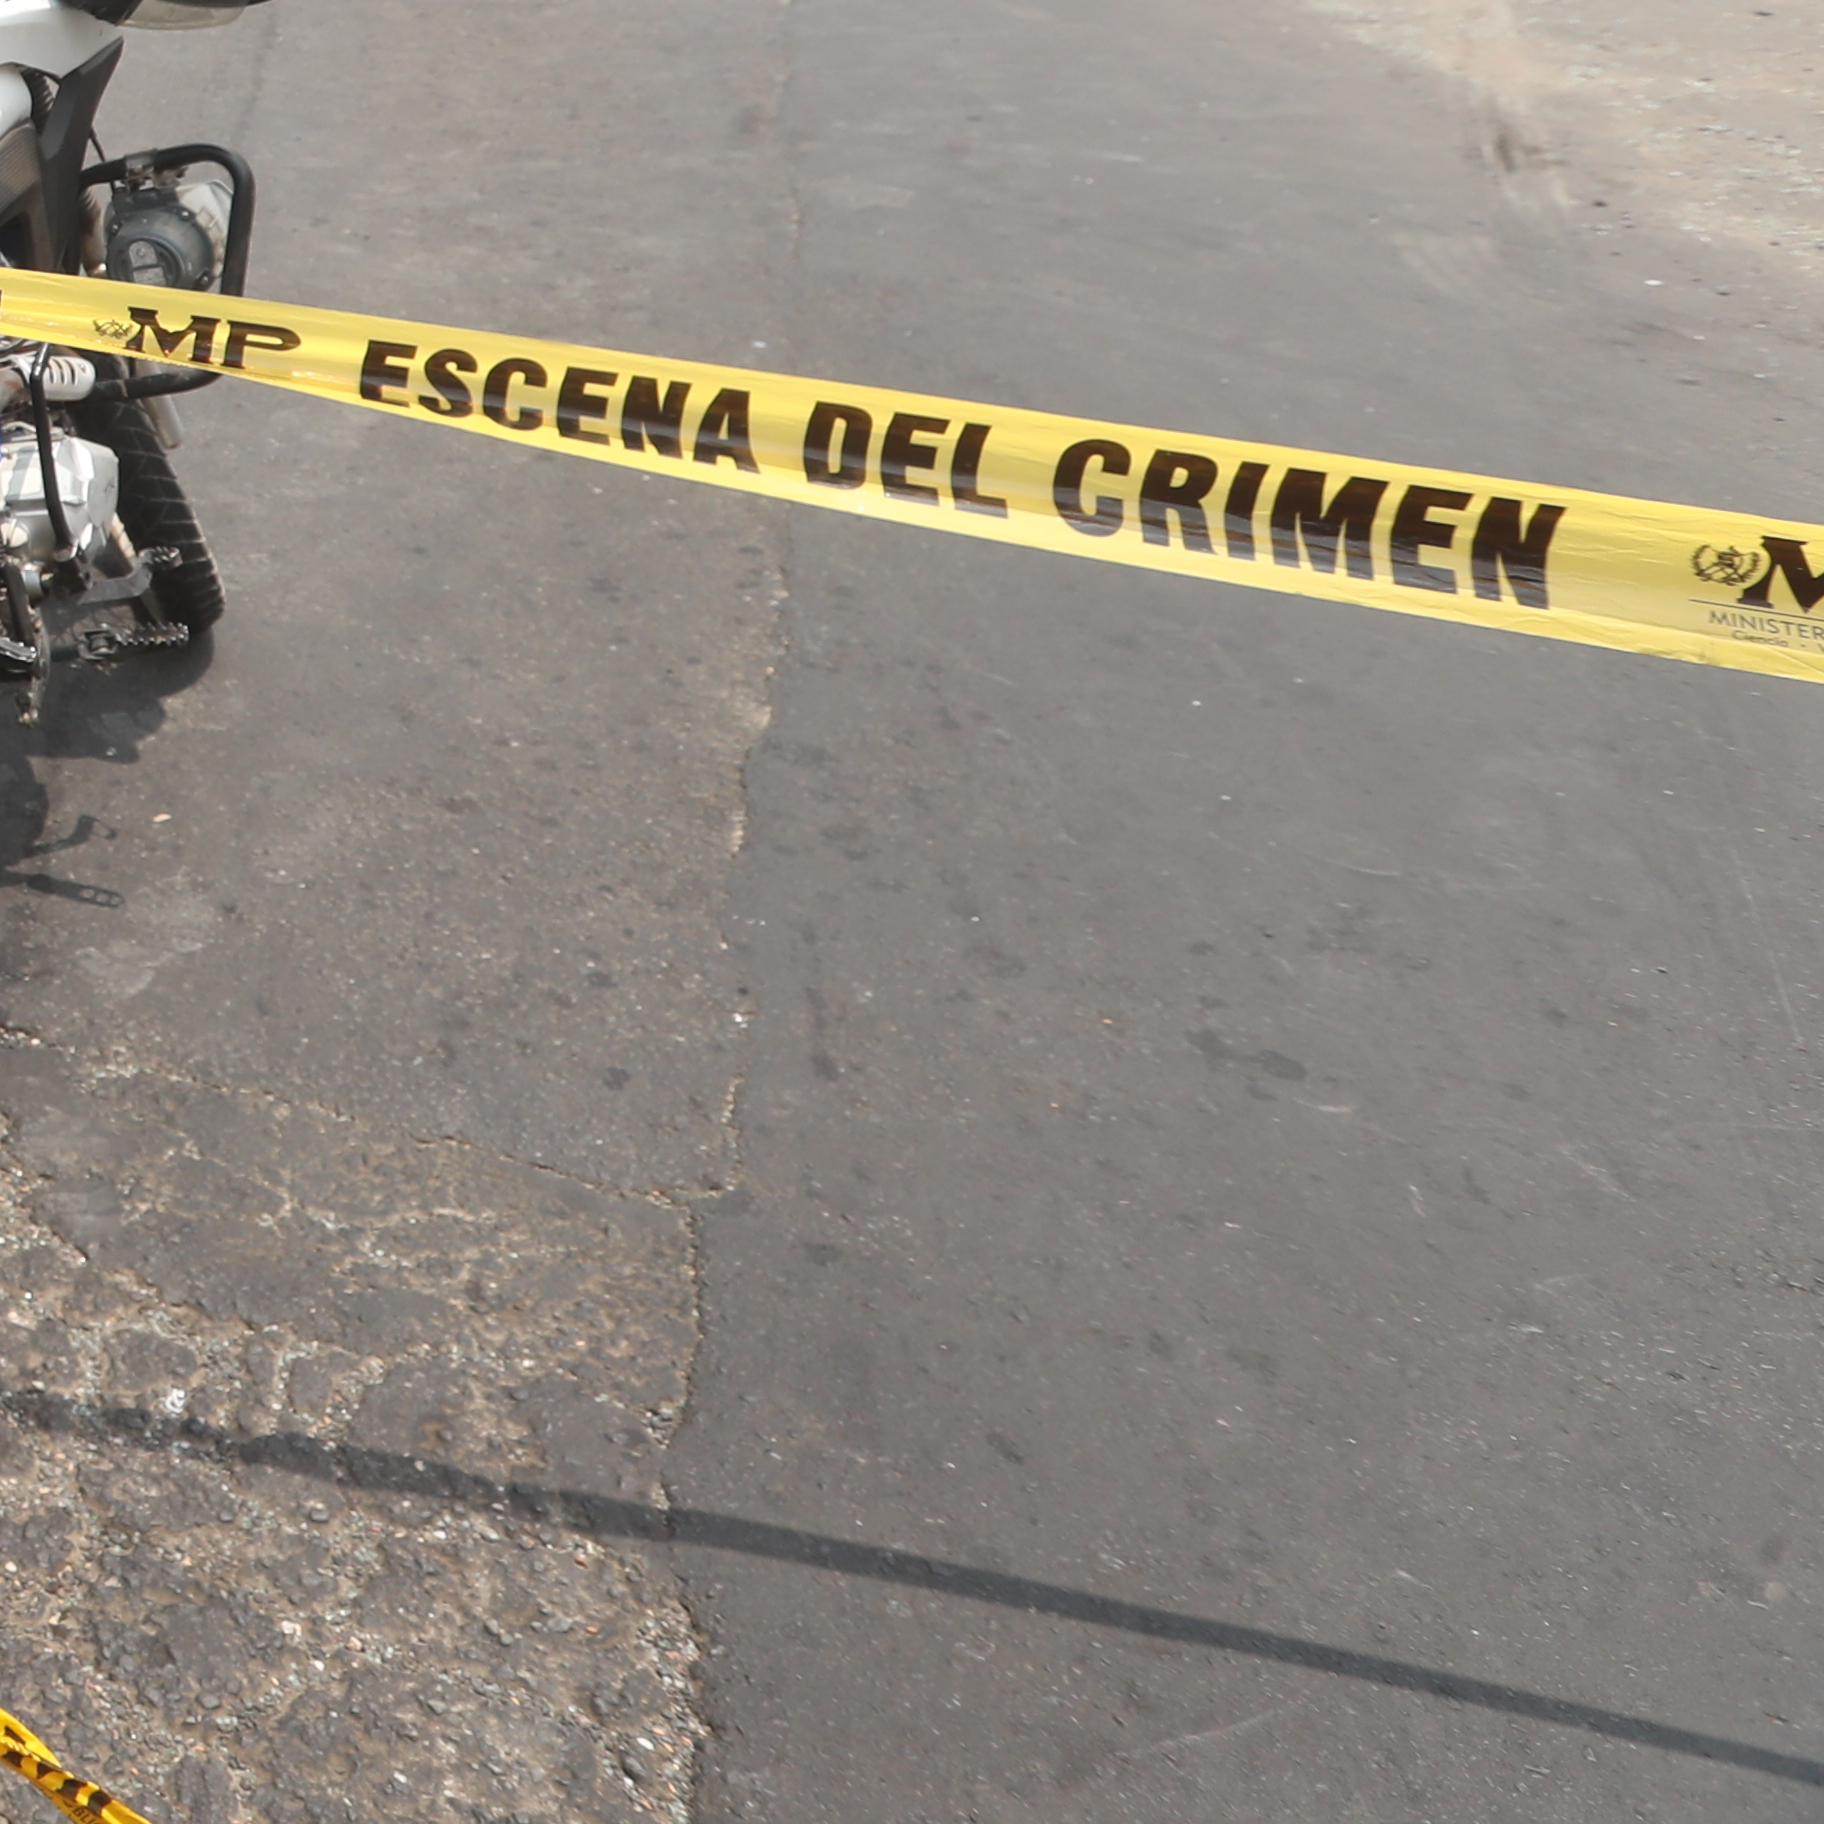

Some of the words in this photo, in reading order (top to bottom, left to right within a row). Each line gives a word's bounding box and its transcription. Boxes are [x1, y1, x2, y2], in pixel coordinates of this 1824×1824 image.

[125, 307, 301, 369] MP
[360, 339, 760, 473] ESCENA
[803, 401, 1008, 518] DEL
[1053, 438, 1567, 610] CRIMEN
